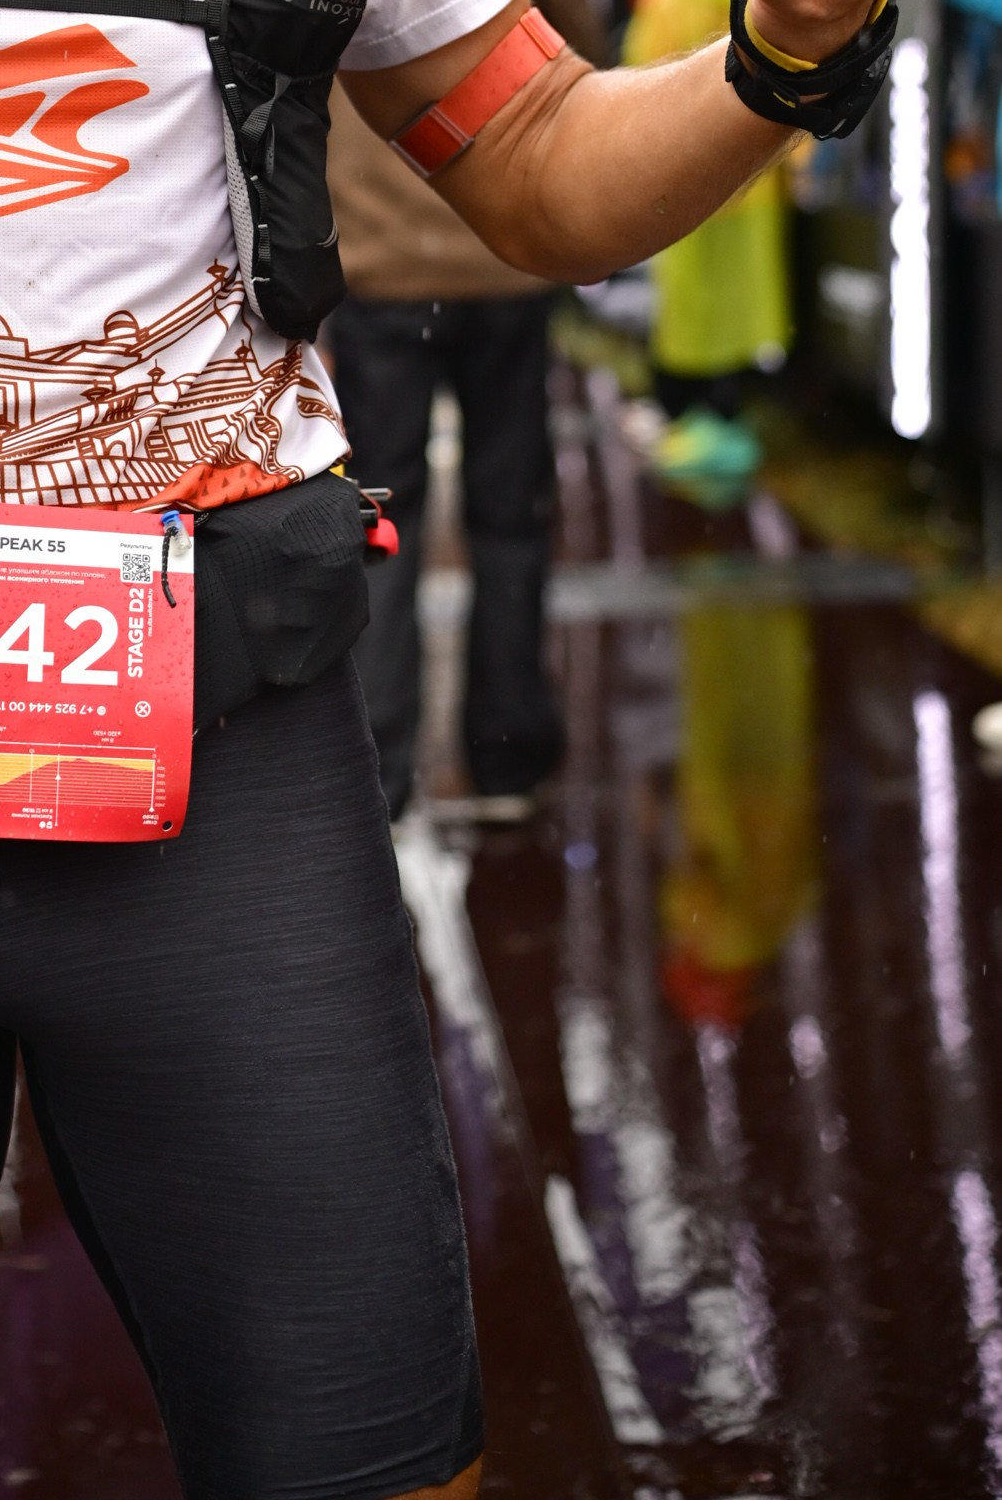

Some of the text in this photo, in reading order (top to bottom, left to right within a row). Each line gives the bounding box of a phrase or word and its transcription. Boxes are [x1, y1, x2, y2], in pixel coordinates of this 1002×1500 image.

[0, 536, 43, 551] PEAK
[47, 539, 66, 553] 55
[128, 587, 144, 679] STAGE D2
[8, 701, 26, 711] 00
[28, 702, 52, 713] 444
[55, 703, 77, 713] 925
[80, 704, 94, 713] +7
